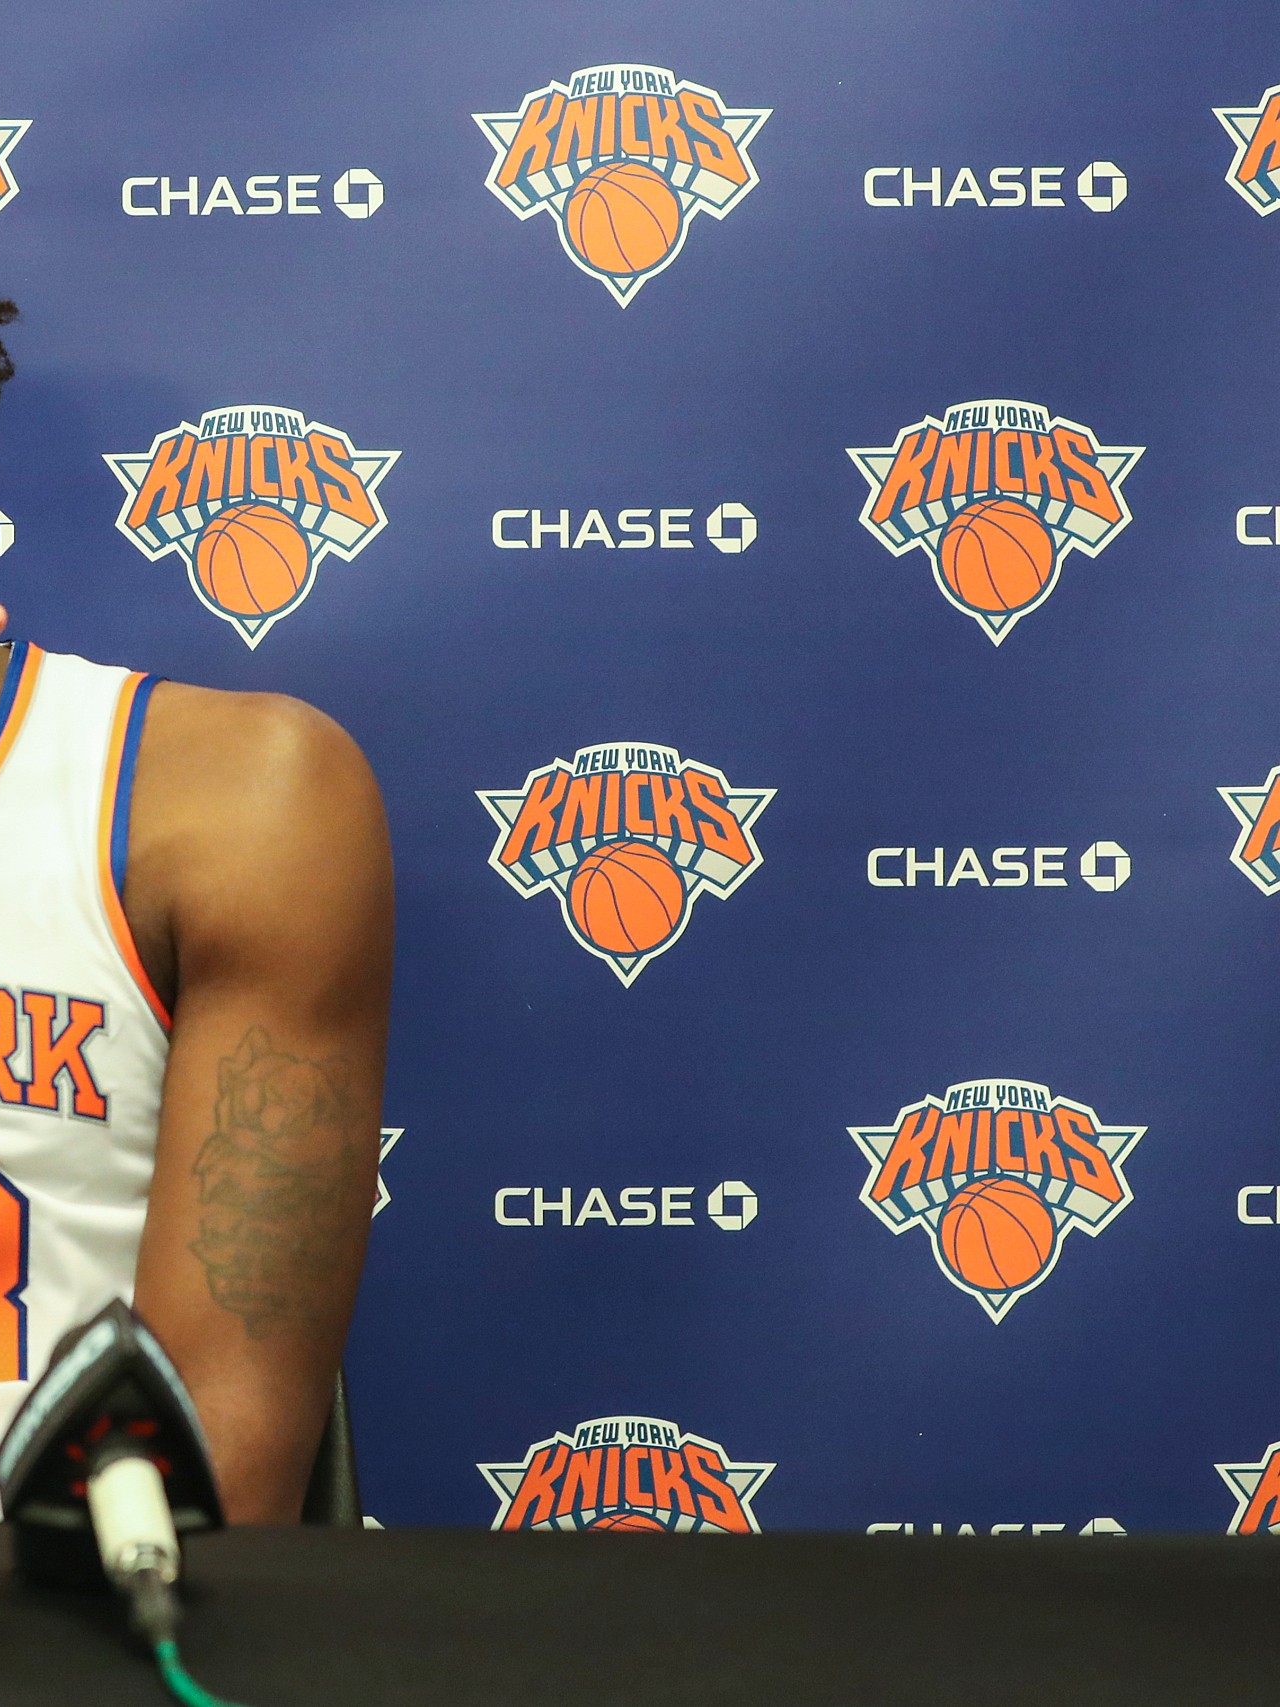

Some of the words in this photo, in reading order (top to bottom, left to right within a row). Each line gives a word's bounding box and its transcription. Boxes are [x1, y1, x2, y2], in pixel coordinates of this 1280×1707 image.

[570, 70, 615, 97] NEW
[621, 69, 673, 96] YORK
[497, 90, 748, 188] KNICKS
[121, 174, 322, 217] CHASE
[863, 166, 1066, 208] CHASE
[200, 411, 245, 439] NEW
[250, 410, 303, 437] YORK
[944, 405, 990, 433] NEW
[995, 405, 1048, 432] YORK
[127, 432, 377, 529] KNICKS
[871, 427, 1122, 524] KNICKS
[490, 508, 695, 550] CHASE
[574, 748, 620, 775] NEW
[624, 747, 678, 775] YORK
[500, 769, 753, 866] KNICKS
[867, 846, 1069, 888] CHASE
[945, 1085, 991, 1112] NEW
[996, 1084, 1049, 1112] YORK
[871, 1106, 1123, 1203] KNICKS
[494, 1186, 696, 1227] CHASE
[575, 1422, 621, 1449] NEW
[625, 1421, 678, 1449] YORK
[502, 1443, 751, 1534] KNICKS
